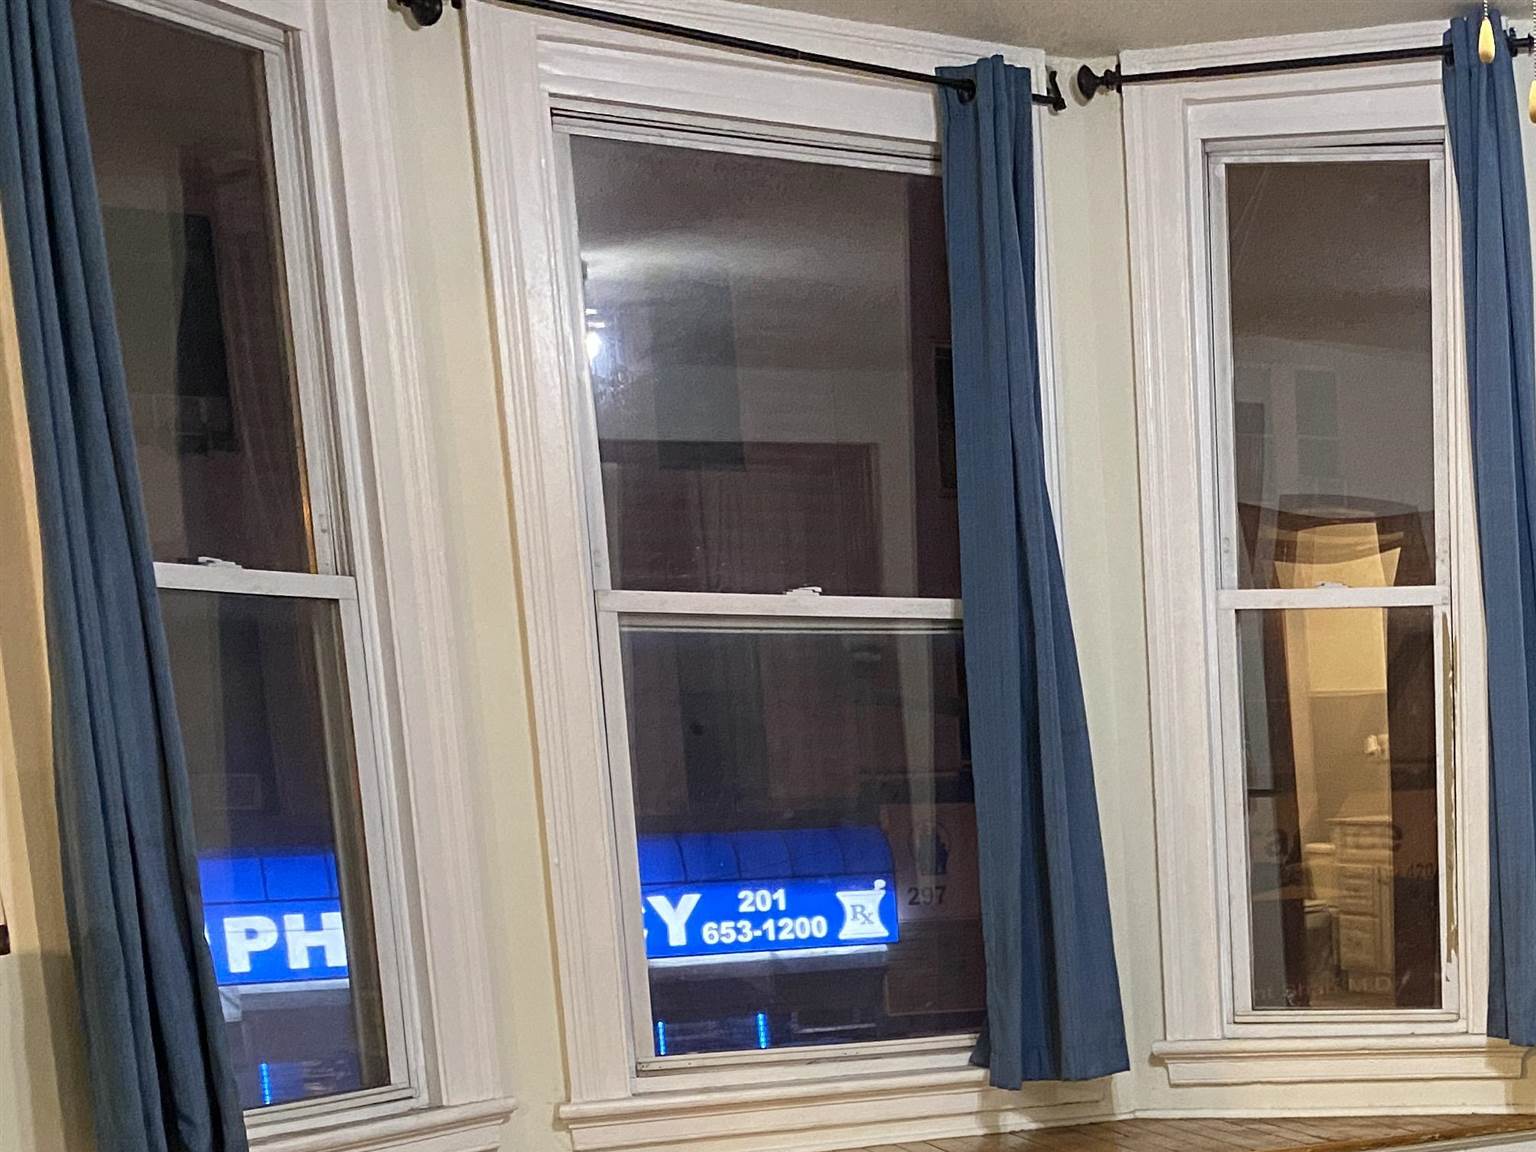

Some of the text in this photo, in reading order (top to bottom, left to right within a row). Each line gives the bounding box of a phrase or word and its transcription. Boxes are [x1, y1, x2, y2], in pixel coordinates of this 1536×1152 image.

[737, 889, 786, 912] 201
[907, 886, 946, 906] 297
[642, 894, 702, 947] Y
[702, 915, 828, 945] 653-1200
[223, 911, 348, 973] PH
